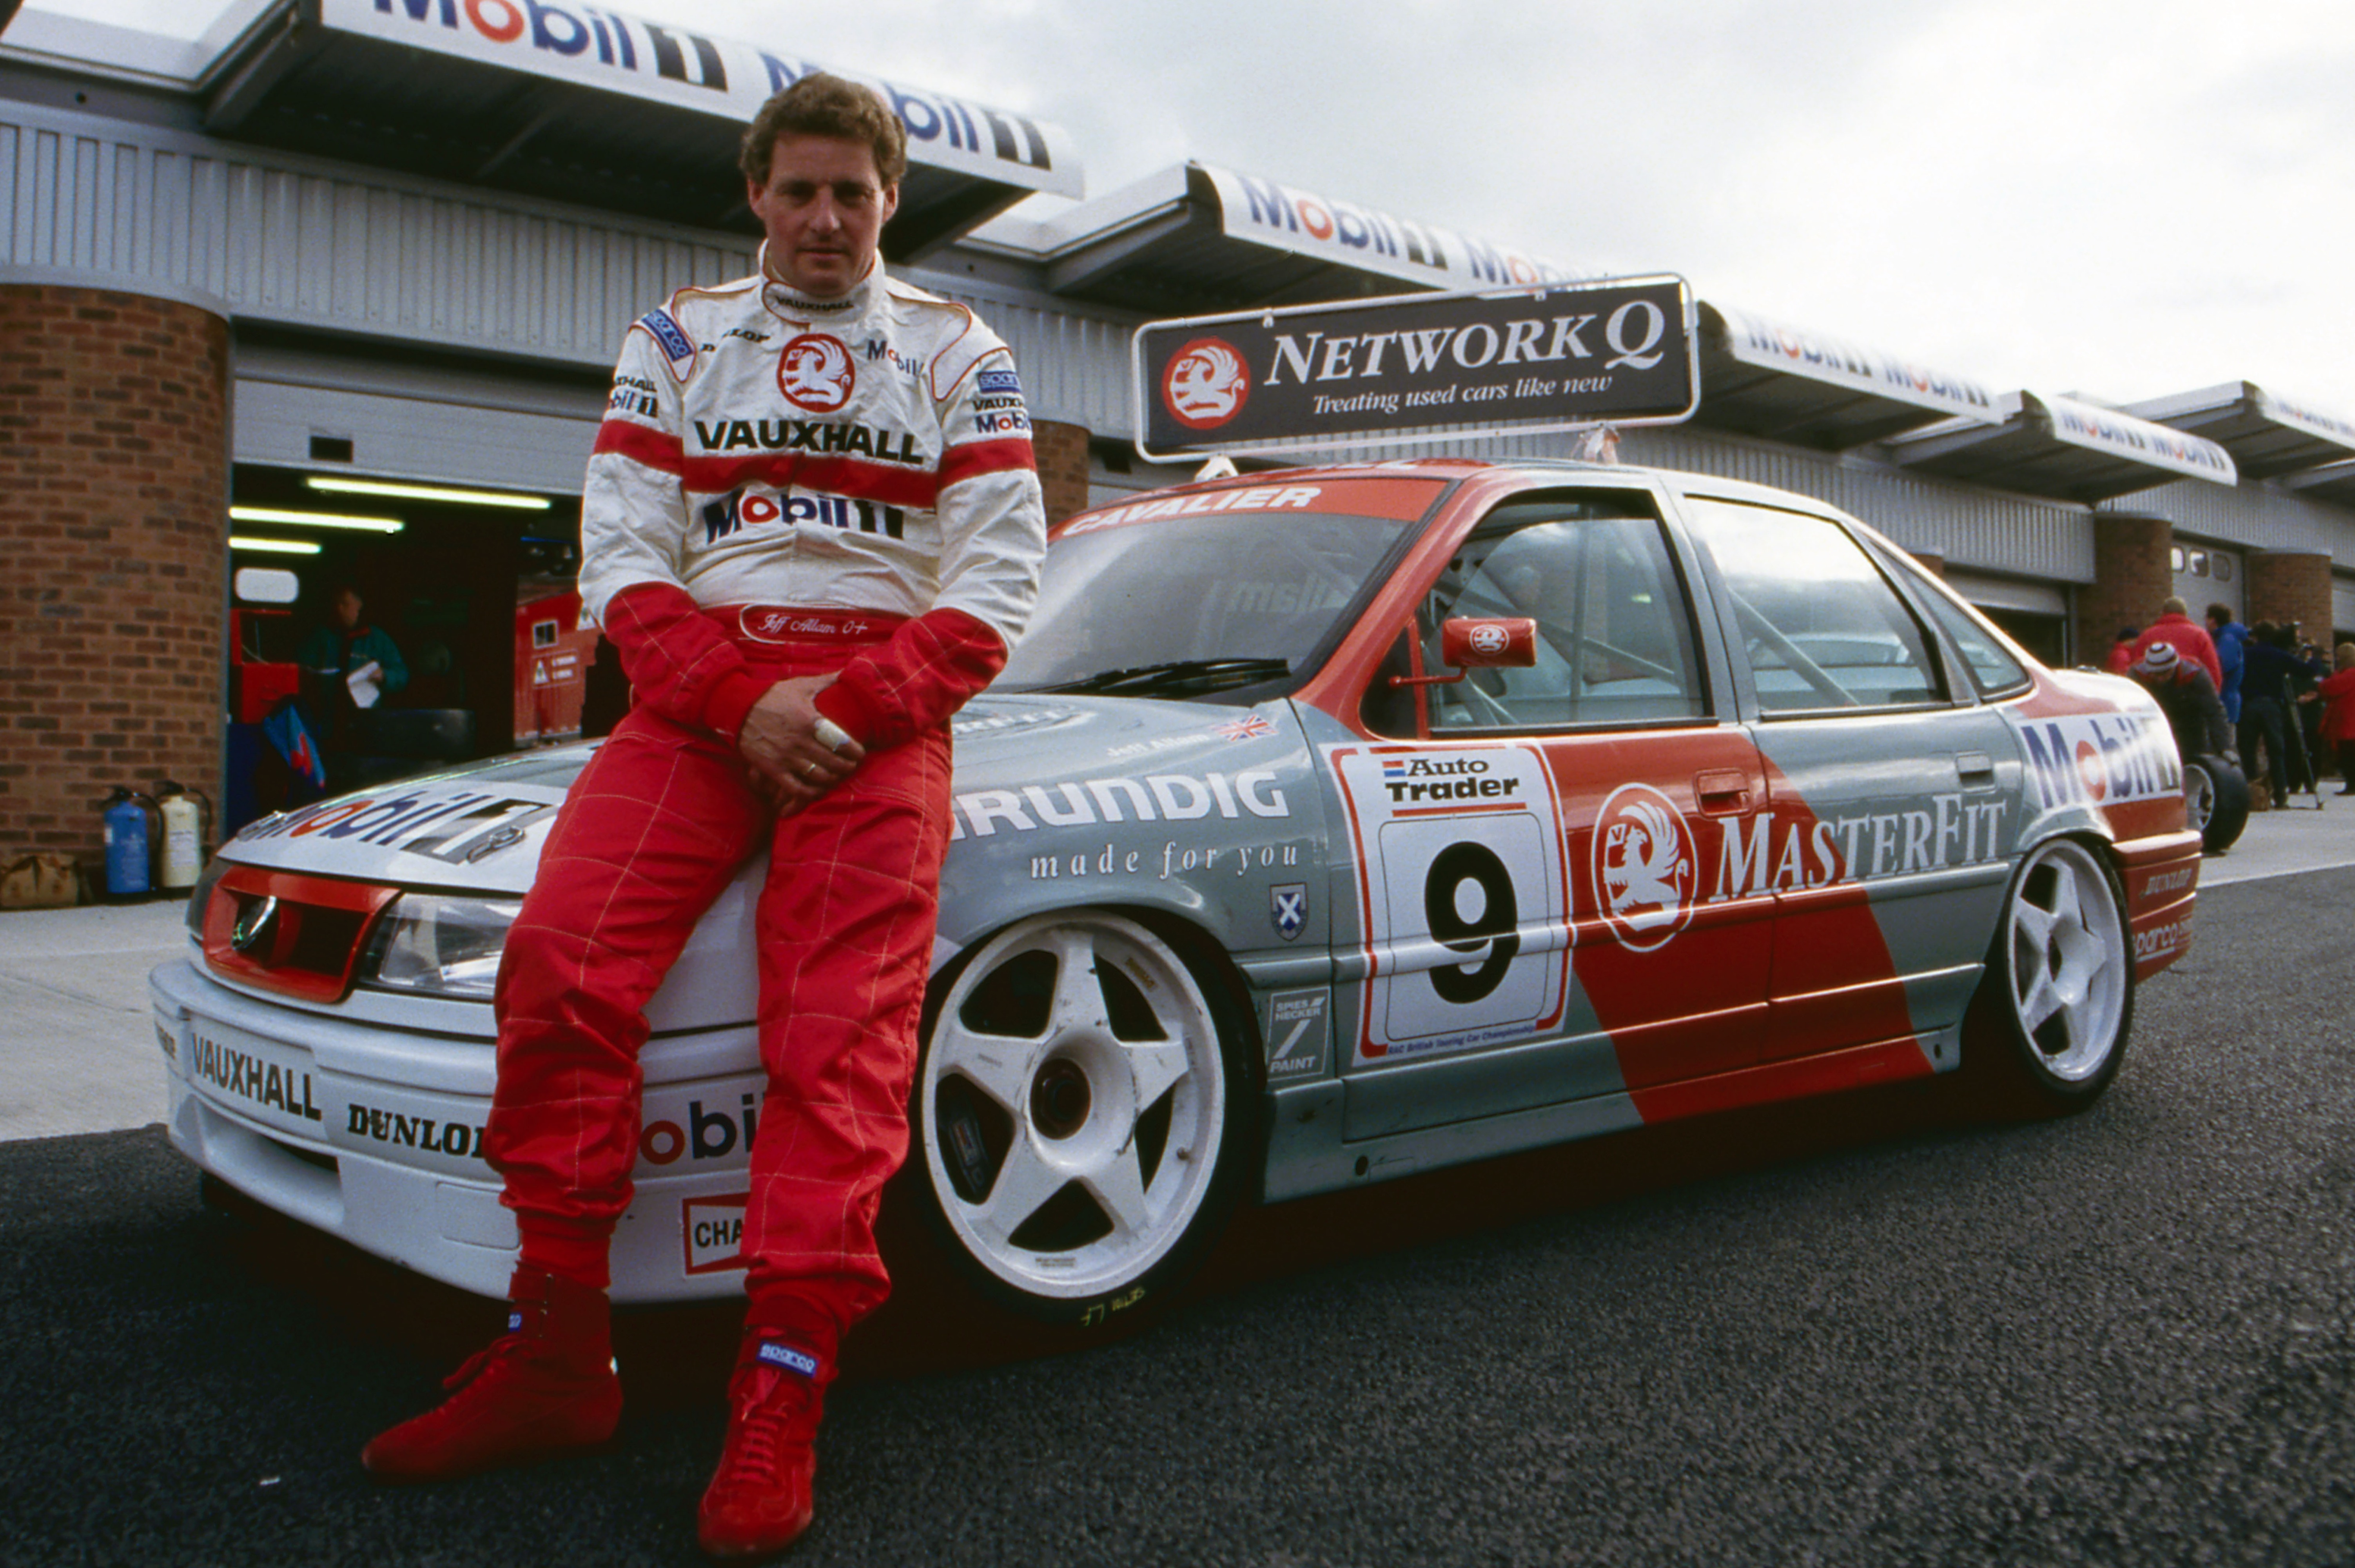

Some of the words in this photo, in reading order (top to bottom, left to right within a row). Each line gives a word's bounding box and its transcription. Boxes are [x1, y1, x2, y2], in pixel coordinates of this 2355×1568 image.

[1239, 176, 1398, 258] Mobil
[775, 295, 855, 311] VAUXHALL
[1263, 314, 1598, 386] NETWORK
[1605, 300, 1665, 370] Q
[1313, 393, 1399, 415] Treating
[1406, 385, 1457, 407] used
[1462, 381, 1508, 402] cars
[1515, 377, 1557, 399] like
[1563, 376, 1613, 393] new
[693, 419, 924, 465] VAUXHALL
[703, 488, 849, 545] Mobil
[1063, 487, 1321, 536] CAVALIER
[758, 614, 791, 634] Jeff
[790, 618, 836, 634] Allam
[1407, 759, 1489, 777] Auto
[951, 772, 1290, 841] RUNDIG
[1385, 778, 1519, 802] Trader
[1031, 844, 1139, 879] made
[1158, 841, 1218, 880] for
[1237, 845, 1298, 877] you
[1425, 841, 1520, 1004] 9
[1275, 1007, 1321, 1021] HECKER
[1276, 999, 1308, 1012] SPIES
[1467, 1034, 1480, 1043] Car
[192, 1033, 321, 1122] VAUXHALL
[1270, 1055, 1316, 1073] PAINT
[640, 1092, 764, 1165] obi
